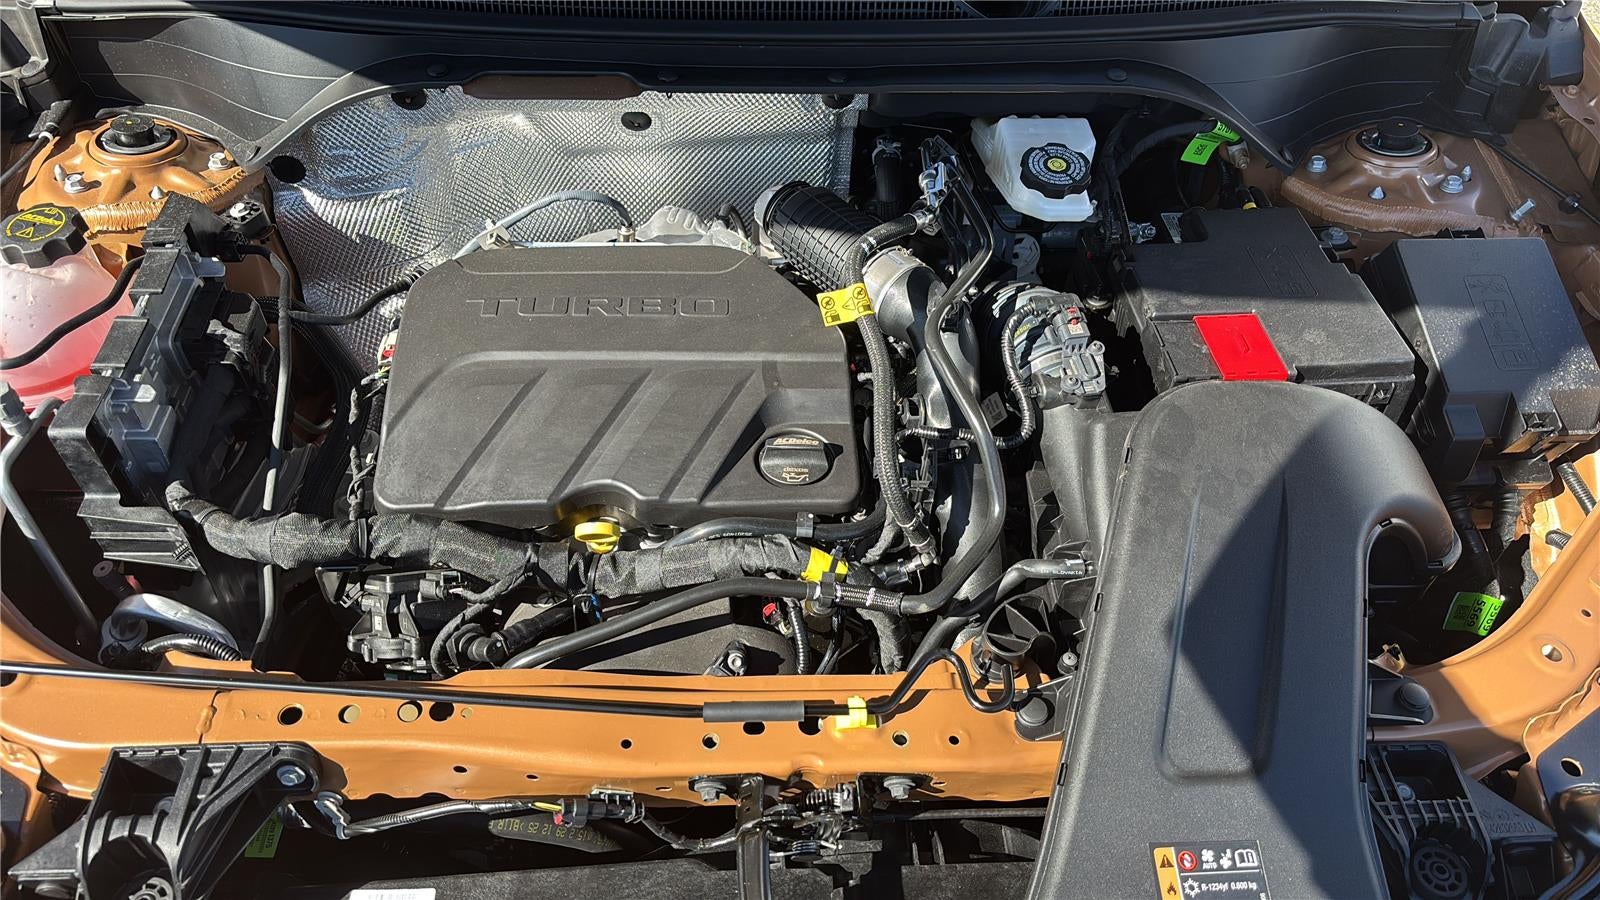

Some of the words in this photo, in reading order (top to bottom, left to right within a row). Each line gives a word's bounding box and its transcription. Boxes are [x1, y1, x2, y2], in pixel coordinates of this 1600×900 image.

[465, 295, 730, 318] TURBO
[773, 438, 819, 446] ACDelco
[1467, 600, 1486, 627] 5569
[527, 822, 540, 834] 25
[541, 823, 552, 835] 12
[1202, 862, 1218, 870] AUTO
[1201, 882, 1228, 892] R-1234yf
[1248, 881, 1257, 890] kg
